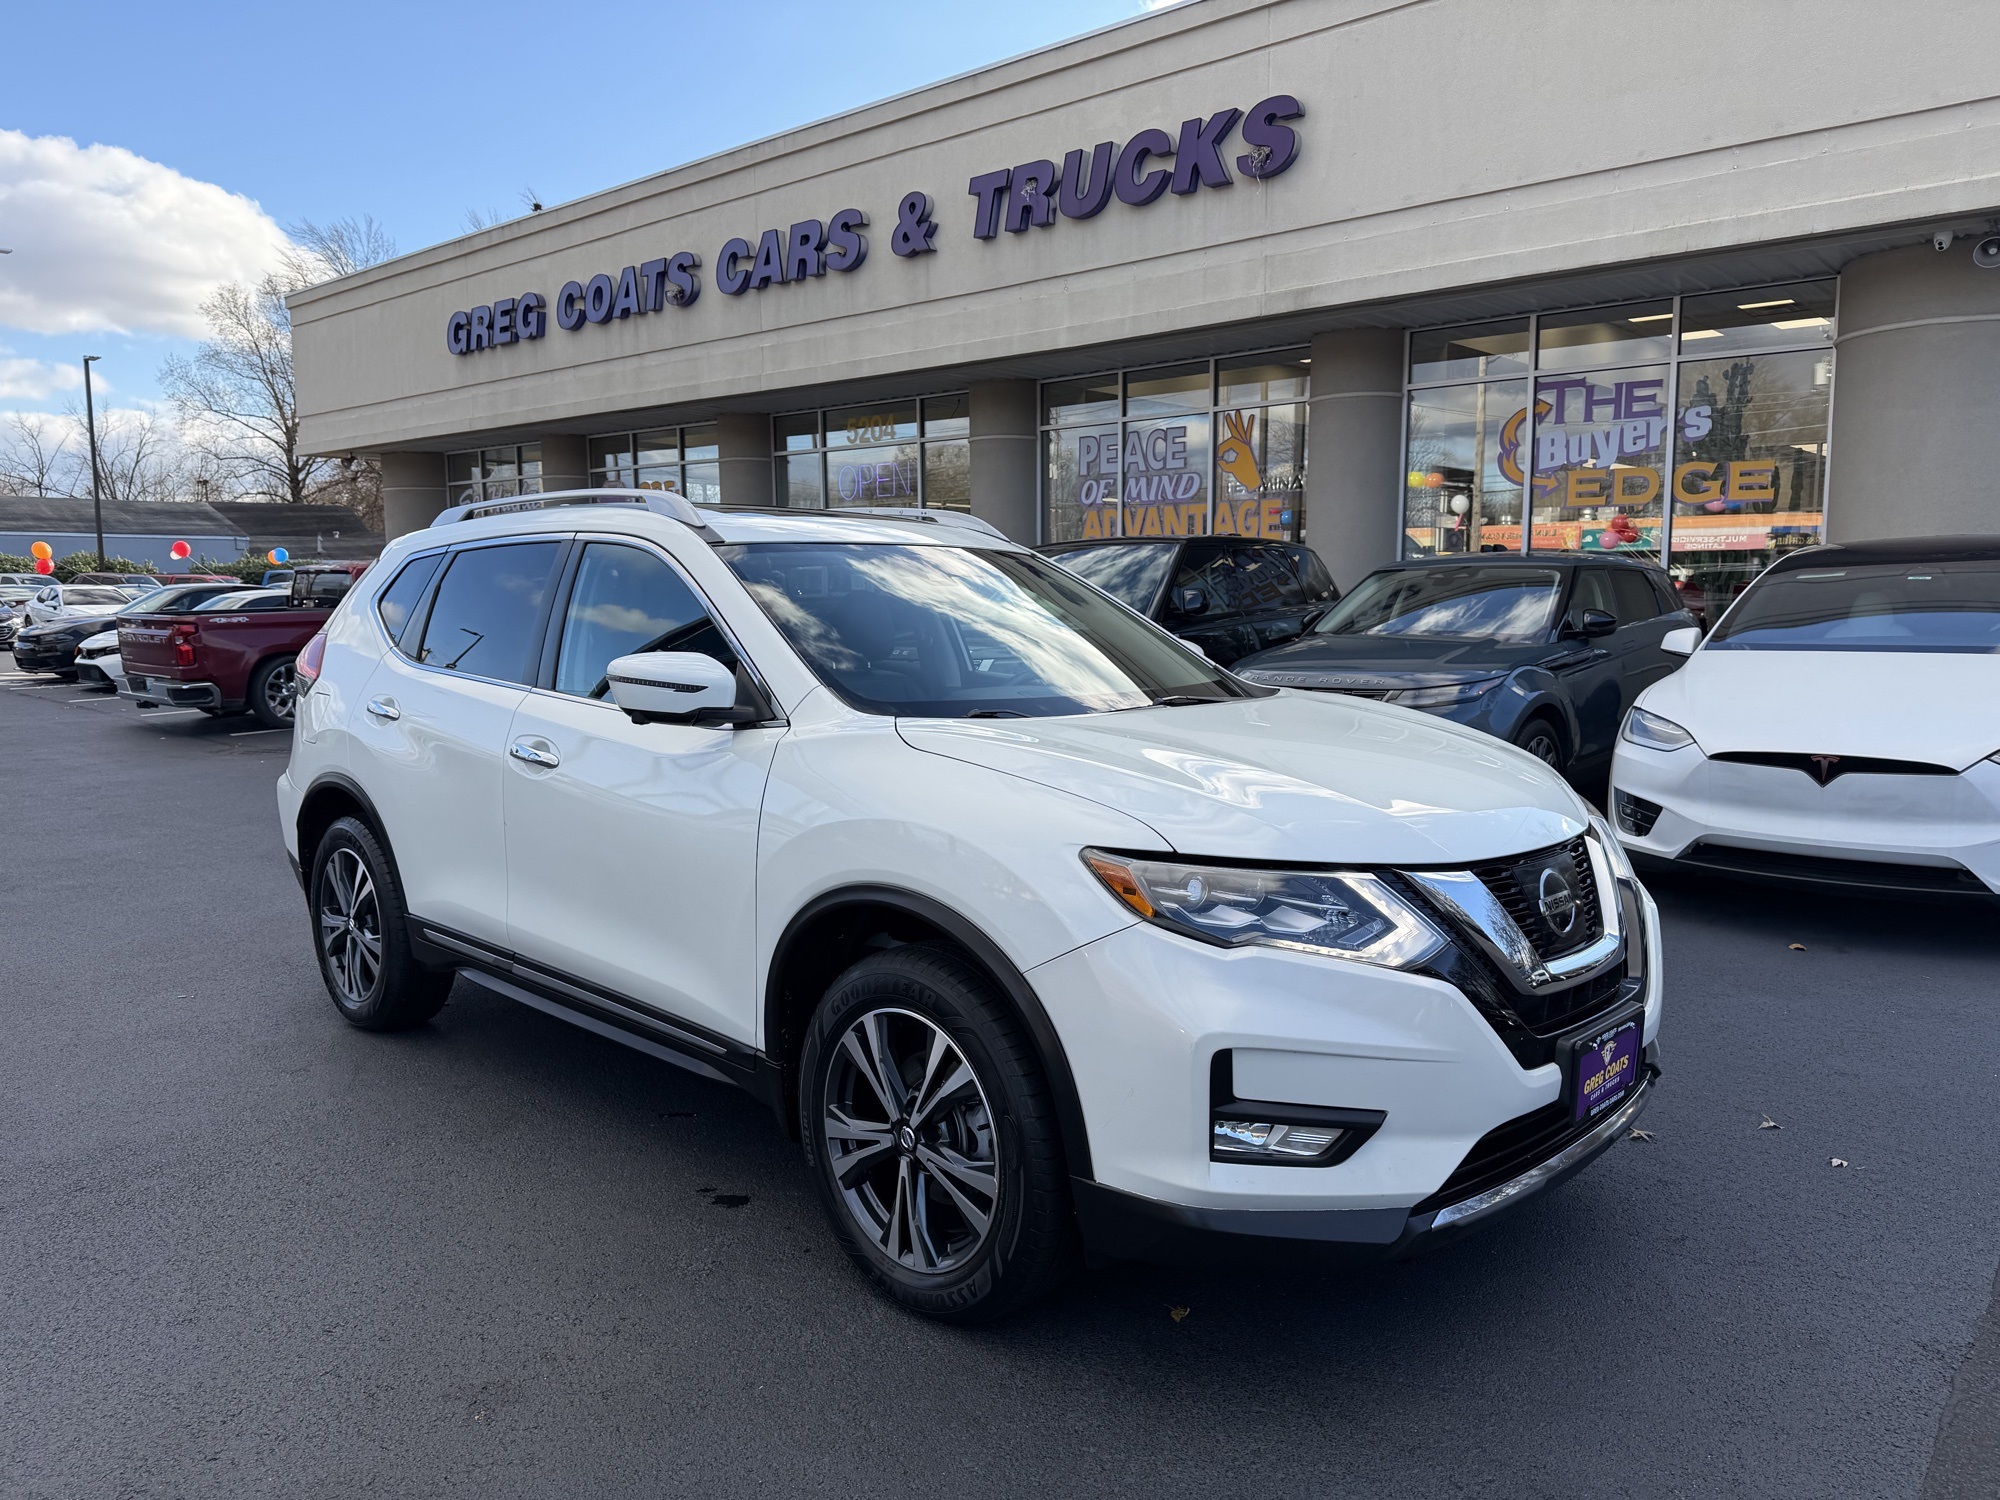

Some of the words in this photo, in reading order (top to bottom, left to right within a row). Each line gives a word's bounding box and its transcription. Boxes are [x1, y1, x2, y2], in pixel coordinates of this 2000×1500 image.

[447, 292, 546, 356] GREG
[556, 251, 702, 331] COATS
[716, 208, 870, 296] CARS
[890, 191, 938, 258] &
[968, 94, 1306, 240] TRUCKS
[1536, 376, 1664, 426] THE
[846, 414, 896, 444] 5204
[1536, 404, 1713, 473] Buyer's
[1078, 426, 1188, 476] PEACE
[838, 461, 911, 500] OPEN
[1079, 478, 1114, 506] OF
[1123, 472, 1201, 503] MIND
[1564, 458, 1777, 510] EDGE
[1081, 499, 1287, 541] ADVANTAGE
[1250, 674, 1307, 684] RANGE
[1318, 677, 1386, 685] ROVER
[1544, 893, 1573, 912] NISSAN
[1583, 1069, 1604, 1095] GREG
[1605, 1054, 1629, 1080] COATS
